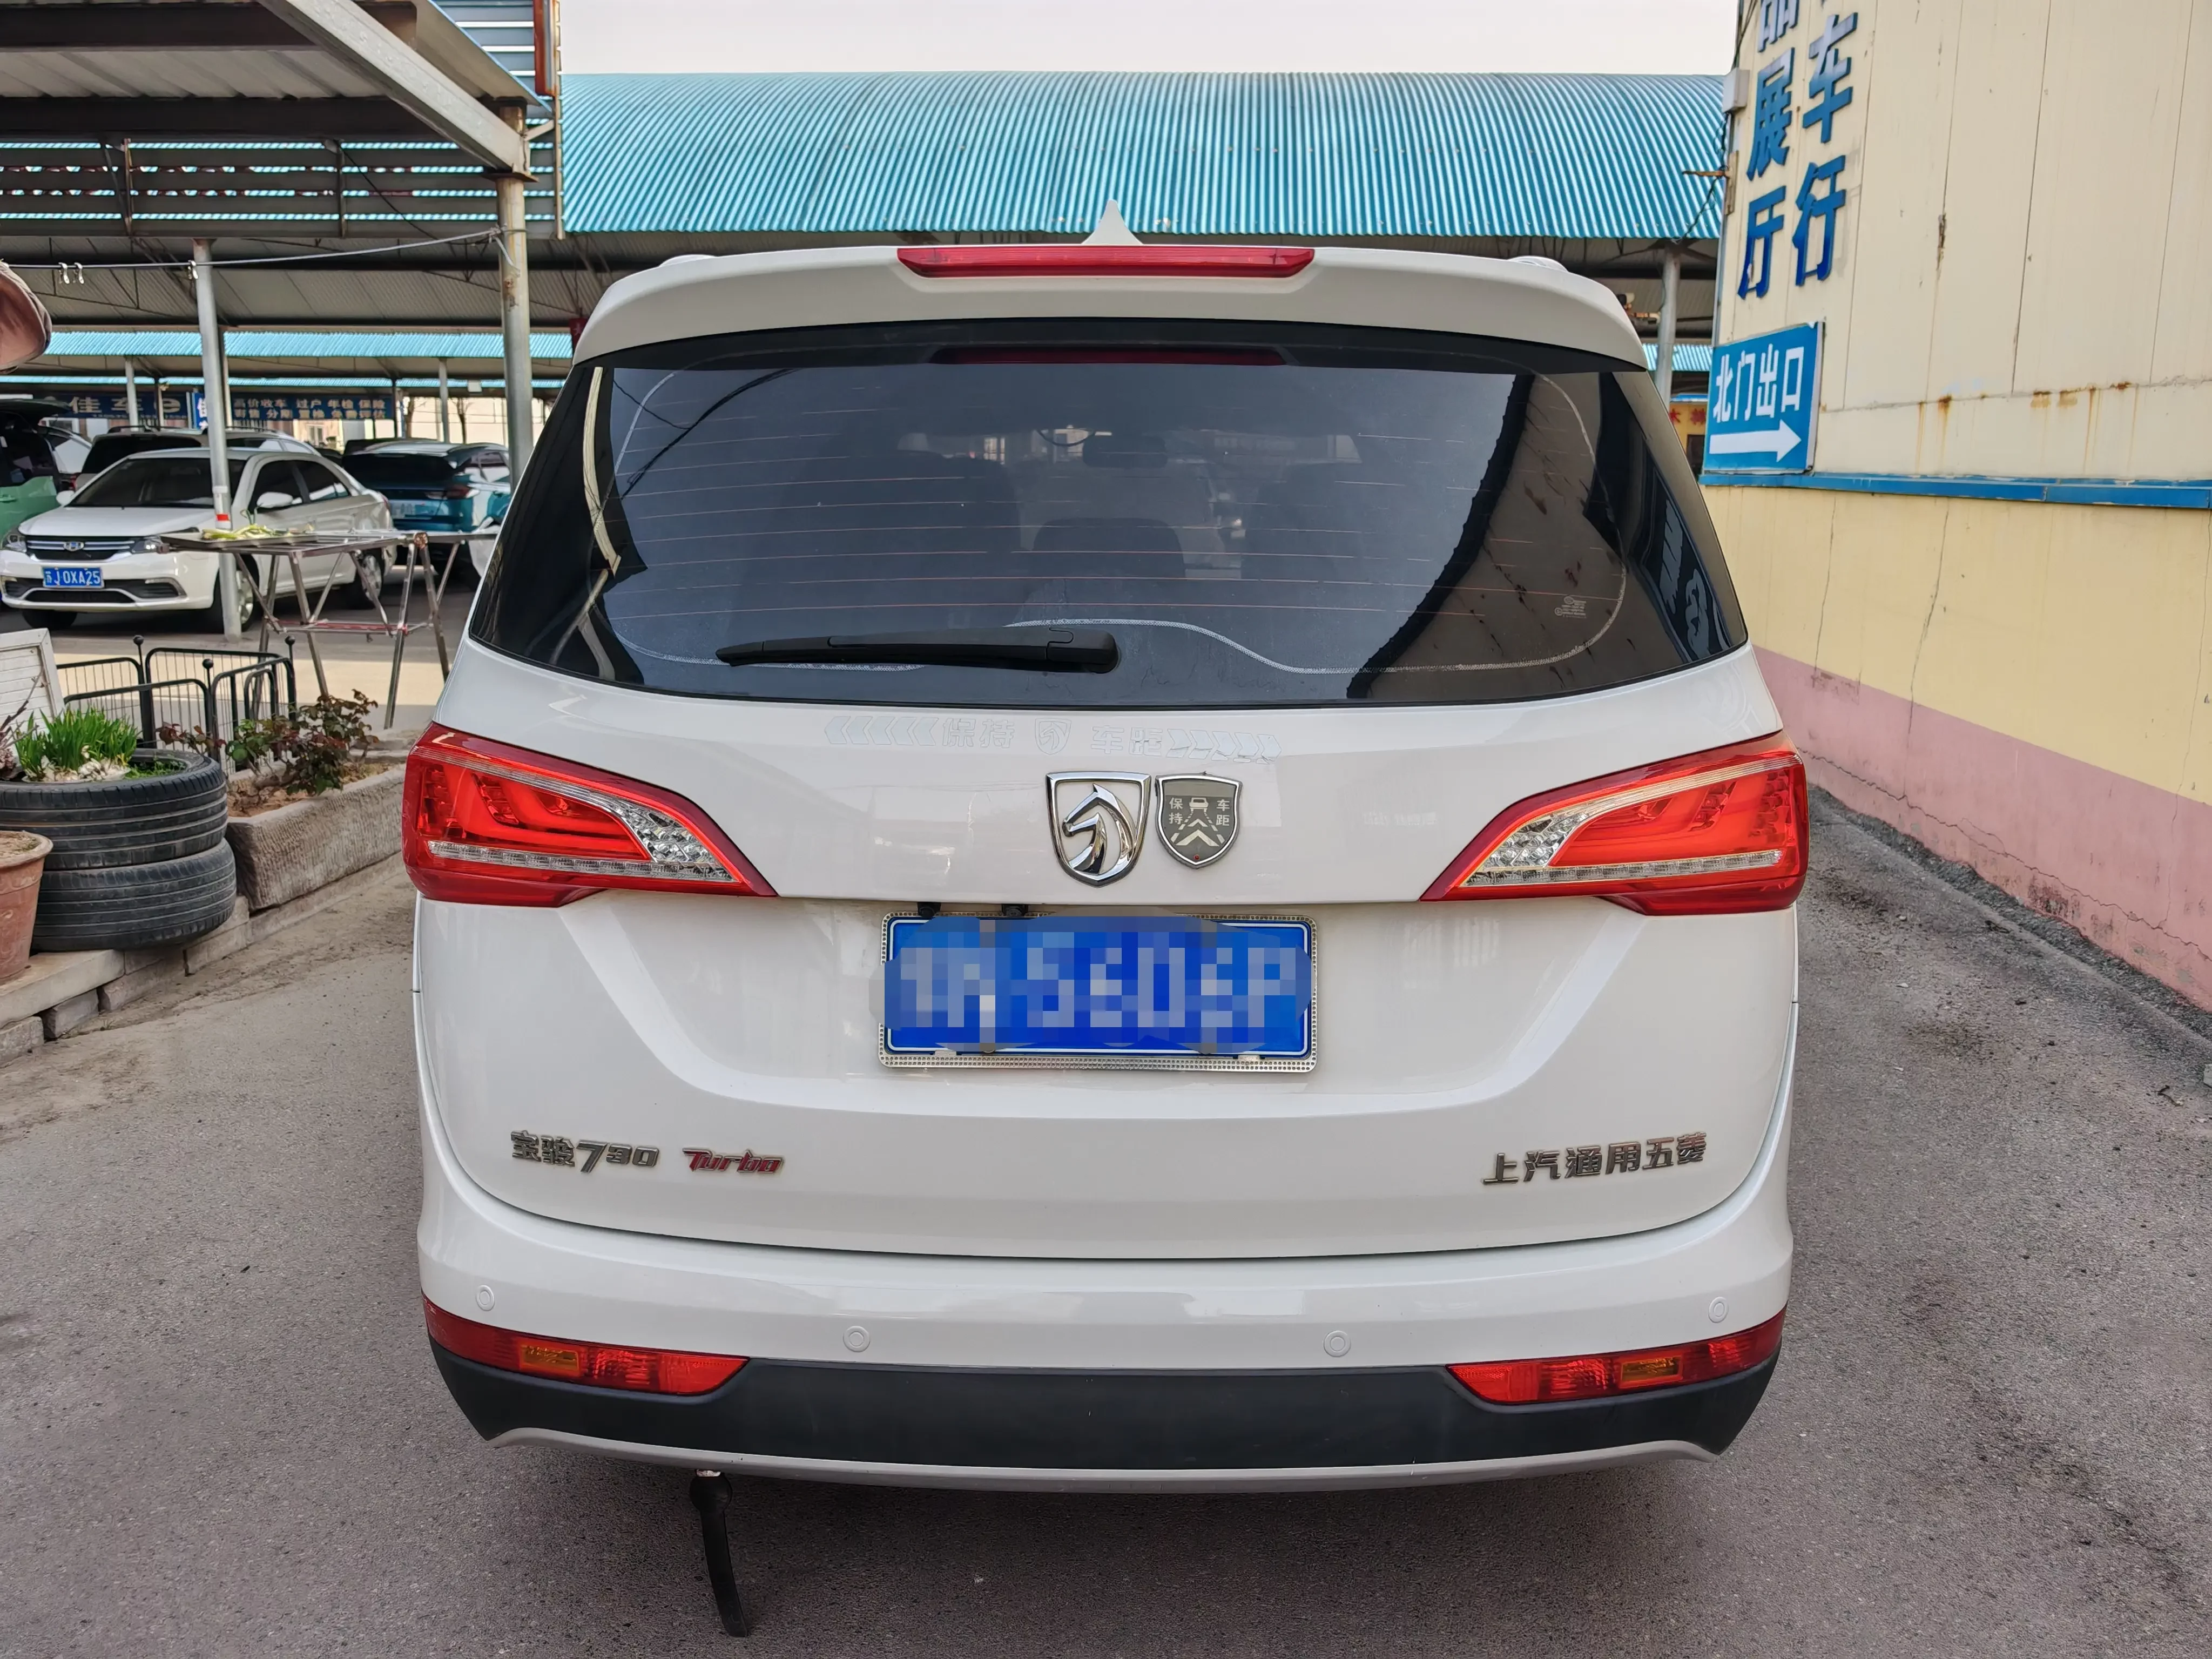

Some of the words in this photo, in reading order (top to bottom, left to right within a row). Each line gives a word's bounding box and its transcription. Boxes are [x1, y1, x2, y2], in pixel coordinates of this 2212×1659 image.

[1792, 12, 1858, 287] 车行
[1713, 343, 1804, 423] 北门出口
[942, 718, 1016, 749] 保持
[1090, 725, 1163, 757] 车距
[1169, 797, 1183, 825] 保持
[1216, 799, 1230, 826] 车距
[682, 1148, 785, 1174] Turbo
[1482, 1131, 1707, 1186] 上汽通用五菱
